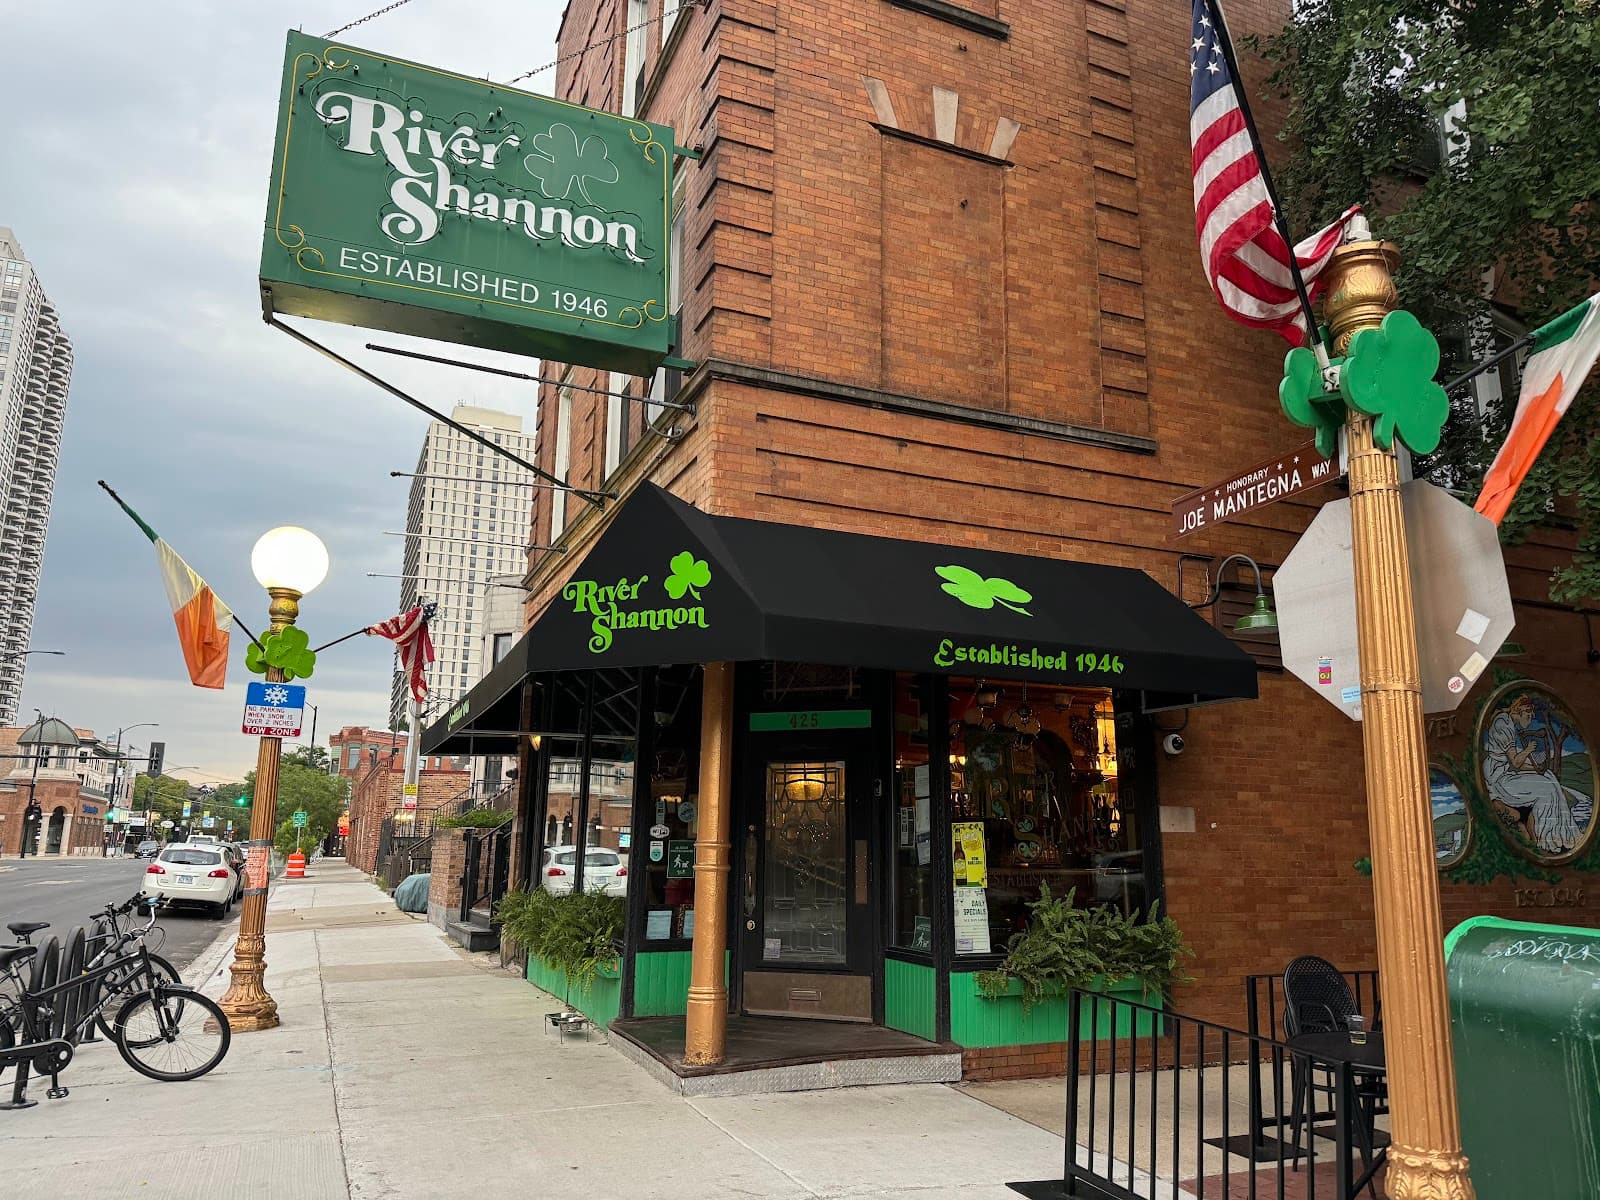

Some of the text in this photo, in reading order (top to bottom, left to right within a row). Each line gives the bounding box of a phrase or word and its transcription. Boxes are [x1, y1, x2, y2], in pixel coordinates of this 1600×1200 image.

[315, 91, 522, 178] River
[381, 157, 647, 263] Shannon
[339, 246, 609, 319] ESTABLISHED 1946
[1179, 459, 1331, 534] JOE MANTEGNA WAY
[1226, 467, 1269, 493] HONORARY
[562, 574, 649, 617] River
[588, 601, 710, 654] Shannon
[933, 638, 1125, 675] Established 1946
[246, 726, 296, 736] TOW ZONE
[260, 706, 286, 714] PARKING
[789, 713, 818, 729] 425
